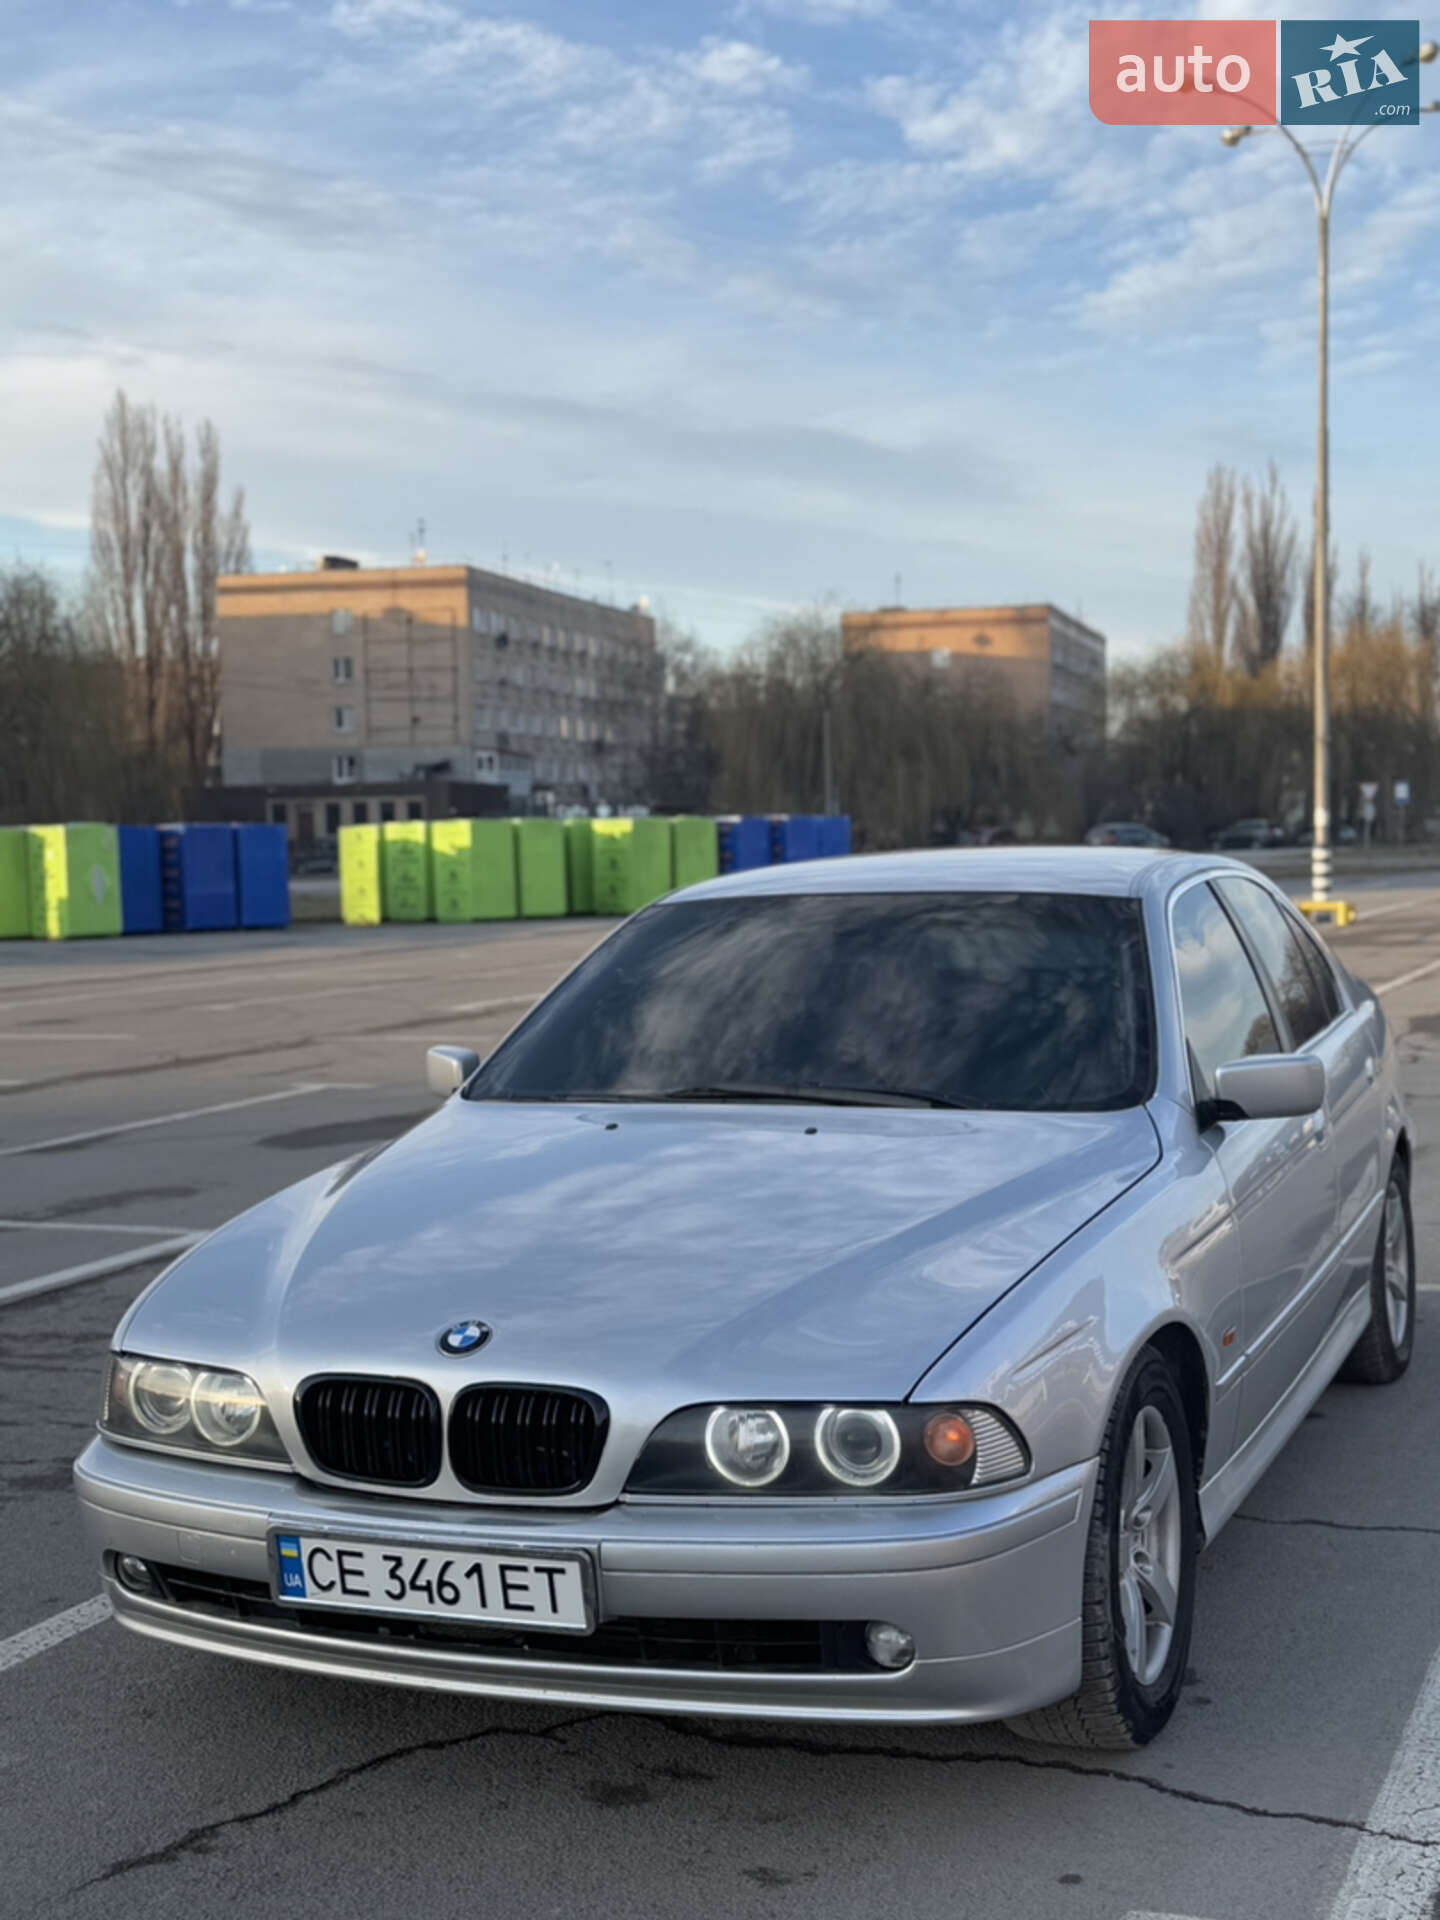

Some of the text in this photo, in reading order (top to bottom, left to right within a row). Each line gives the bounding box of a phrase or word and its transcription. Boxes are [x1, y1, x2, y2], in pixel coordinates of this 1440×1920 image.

[284, 1572, 303, 1589] UA
[307, 1546, 566, 1614] CE 3461 ET
